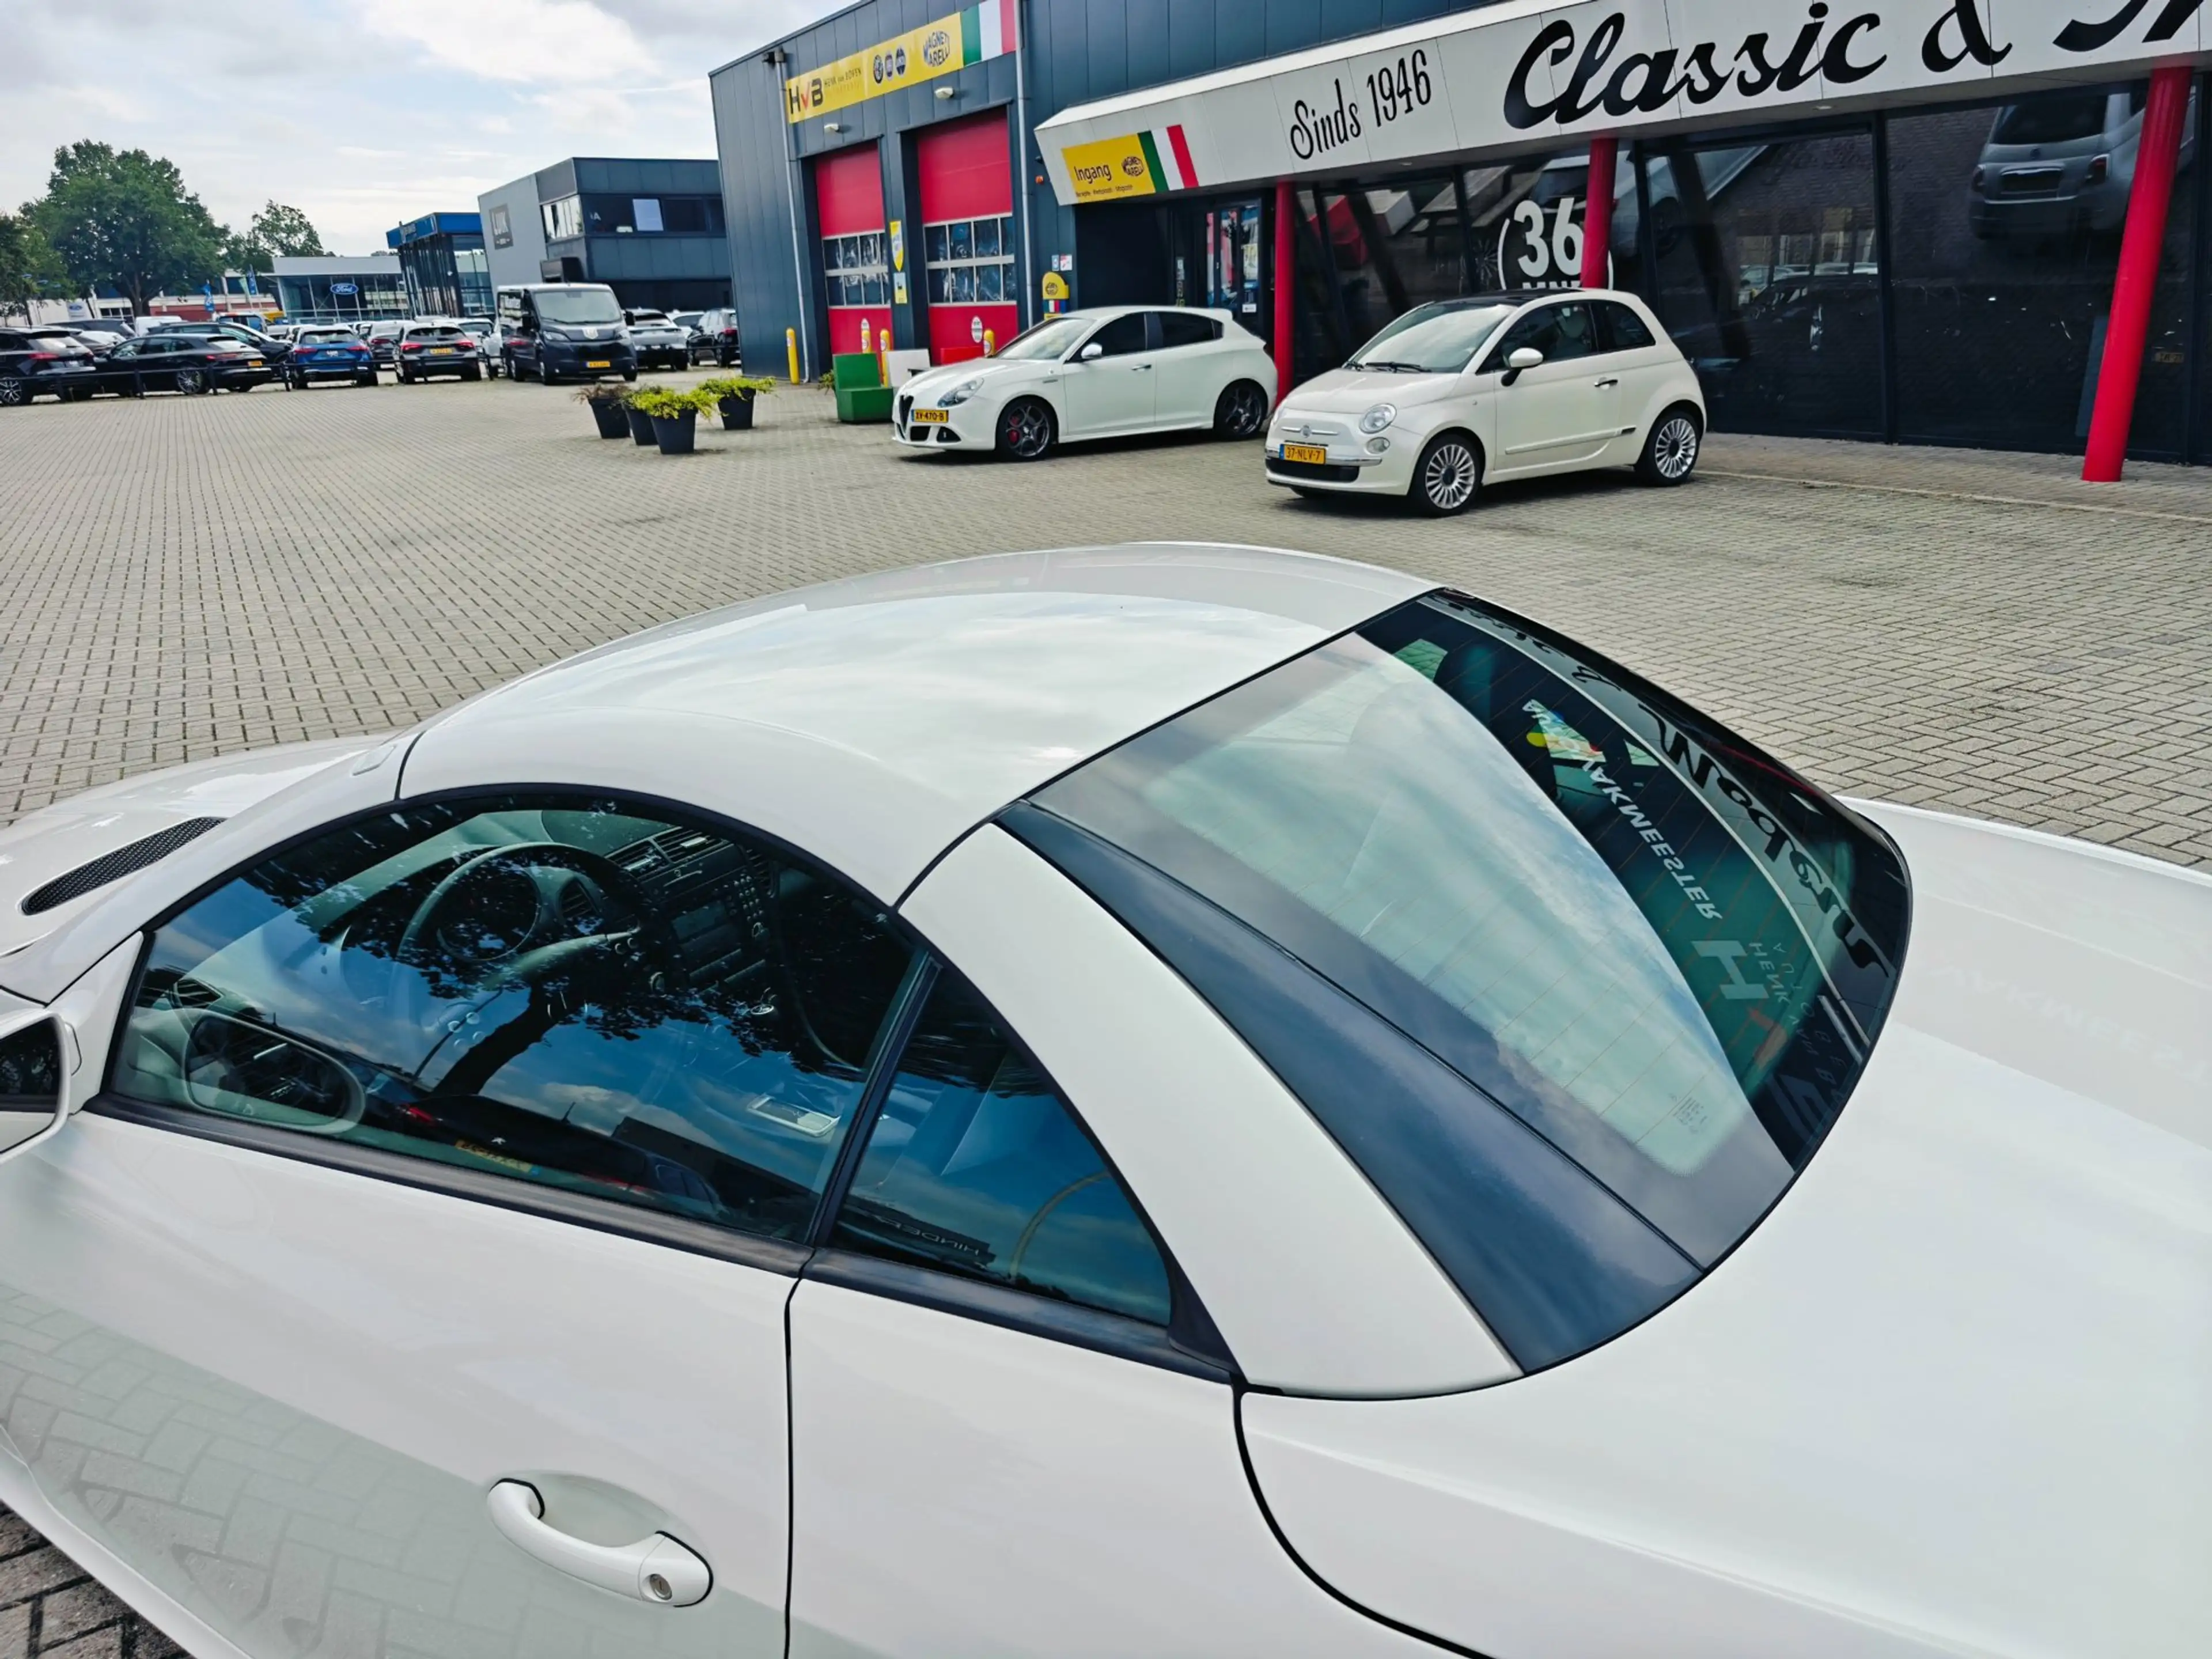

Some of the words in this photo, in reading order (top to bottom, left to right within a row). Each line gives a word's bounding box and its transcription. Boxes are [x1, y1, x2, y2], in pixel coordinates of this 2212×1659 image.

[1290, 78, 1362, 160] Sinds
[1367, 49, 1431, 127] 1946
[1503, 3, 1887, 129] Classic
[1074, 164, 1112, 184] Ingang
[1514, 197, 1585, 278] 36
